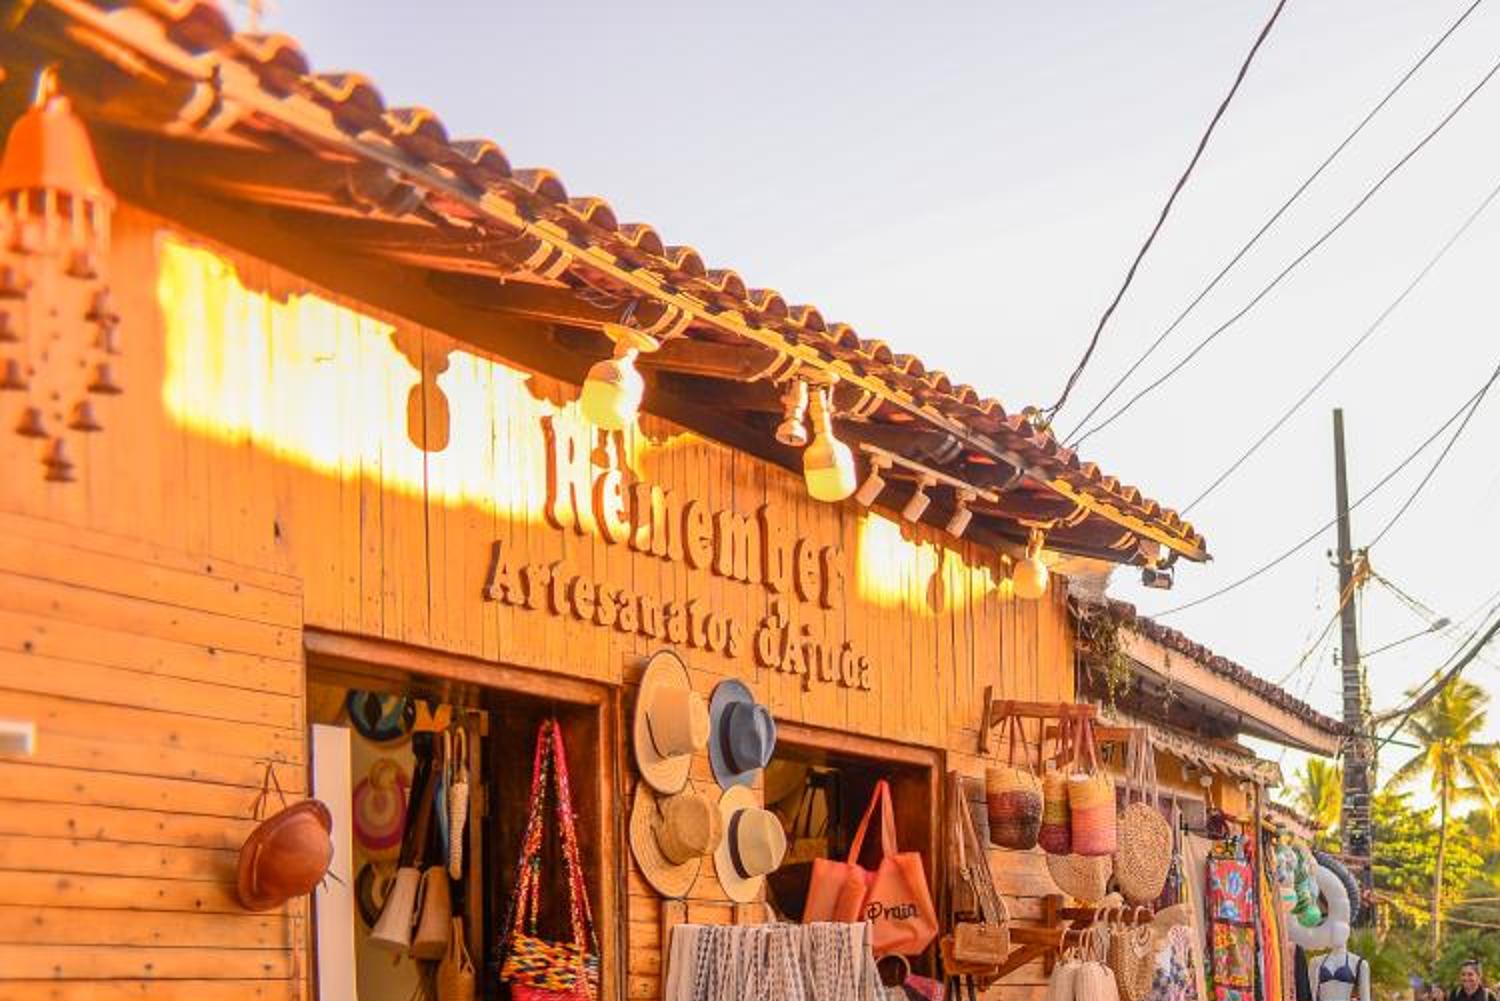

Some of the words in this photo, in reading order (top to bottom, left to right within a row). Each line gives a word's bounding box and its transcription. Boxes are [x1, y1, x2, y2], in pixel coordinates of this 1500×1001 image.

[541, 412, 848, 609] Remember
[483, 539, 744, 658] Artesanatos
[866, 901, 920, 924] Praia
